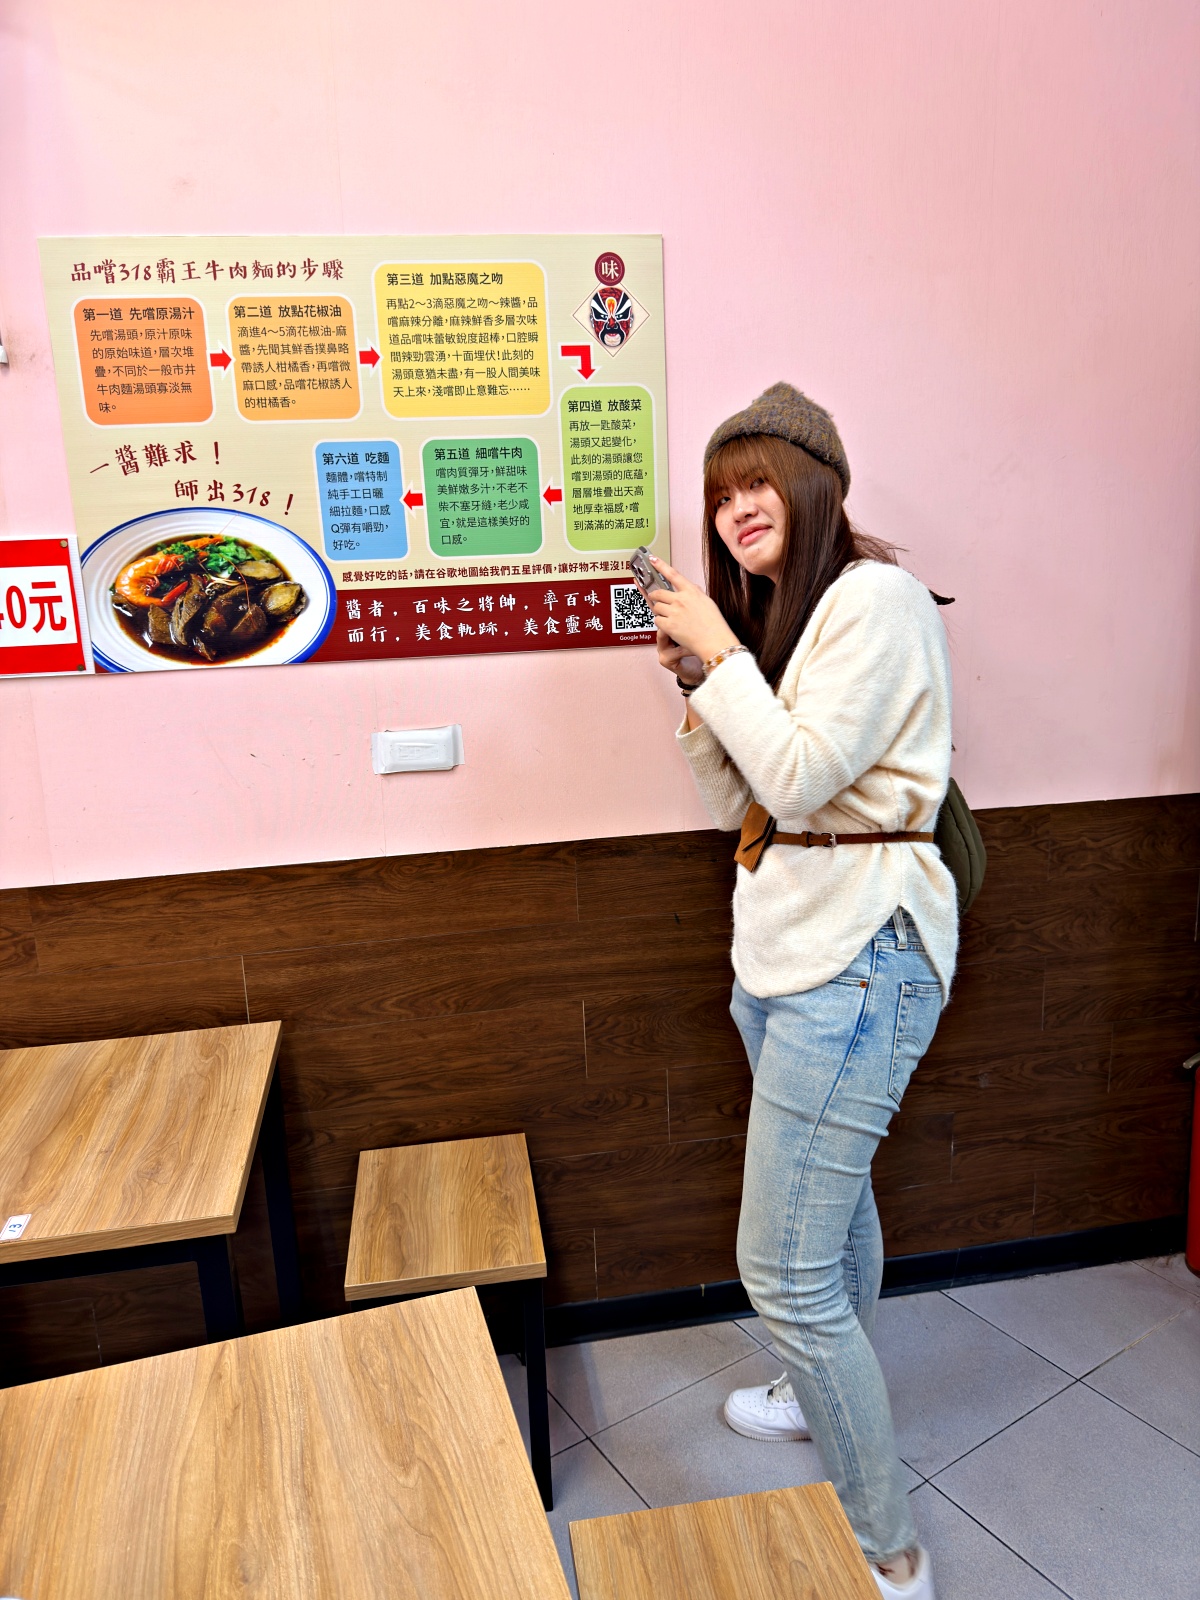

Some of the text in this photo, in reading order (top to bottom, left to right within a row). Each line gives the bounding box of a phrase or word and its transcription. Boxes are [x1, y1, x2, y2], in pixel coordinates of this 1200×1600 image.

[70, 257, 344, 284] 品嚐318霸王牛肉麵的步驟
[601, 259, 619, 280] 味
[386, 272, 503, 286] 第三道 加點惡魔之吻
[82, 306, 195, 321] 第一道 先嚐原湯汁
[233, 304, 342, 318] 第二道 放點花椒油
[90, 328, 193, 342] 先嚐湯頭，原汁原味
[92, 346, 194, 360] 的原始味道，層次堆
[96, 382, 193, 396] 牛肉麵湯頭寡淡無
[242, 378, 352, 391] 麻口感，品嚐花椒誘人
[98, 401, 116, 414] 味。
[244, 396, 296, 408] 的柑橘香。
[568, 399, 642, 413] 第四道 放酸菜
[89, 440, 220, 476] 一醬難求！
[322, 452, 390, 466] 第六道 吃麵
[434, 446, 523, 461] 第五道 細嚐牛肉
[570, 452, 643, 466] 此刻的湯頭讓您
[174, 479, 294, 516] 師出318！
[327, 488, 384, 500] 純手工日曬
[572, 486, 644, 498] 層層堆疊出天高
[329, 504, 391, 517] 細拉麵，口感
[573, 502, 640, 515] 地厚幸福感，嚐
[440, 516, 530, 529] 宜，就是這樣美好的
[332, 539, 360, 551] 好吃。
[442, 534, 468, 546] 口感。
[0, 581, 67, 634] 0元
[620, 634, 652, 642] Google Map
